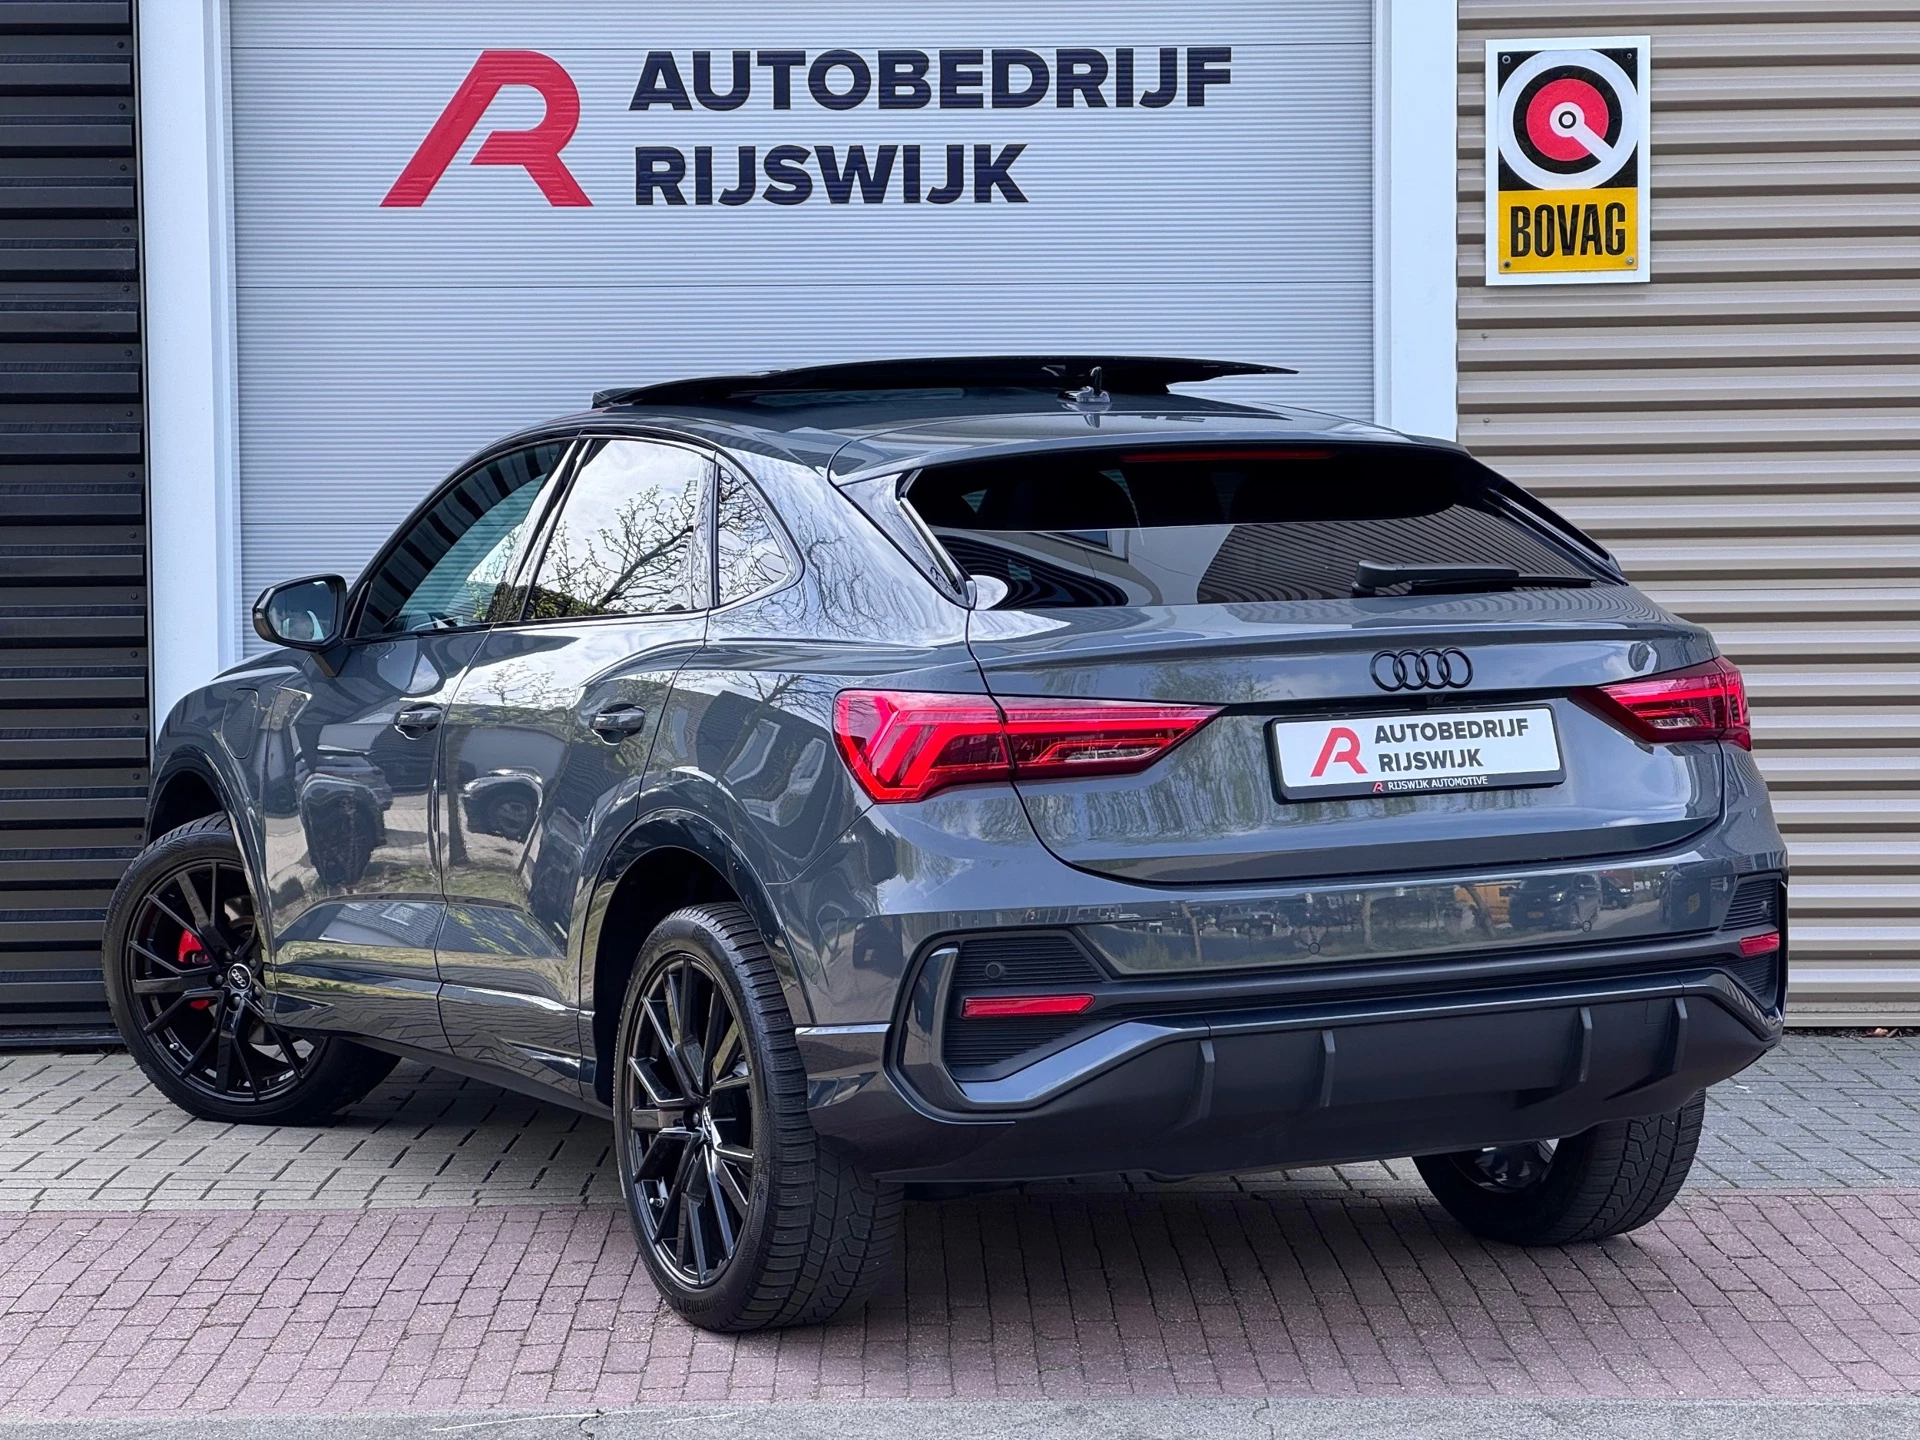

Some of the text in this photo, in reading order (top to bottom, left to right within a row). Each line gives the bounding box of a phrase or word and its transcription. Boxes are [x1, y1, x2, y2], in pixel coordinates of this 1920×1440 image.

[629, 47, 1232, 112] AUTOBEDRIJF
[634, 143, 1029, 207] RIJSWIJK
[1510, 202, 1627, 258] BOVAG
[1374, 717, 1529, 744] AUTOBEDRIJF
[1378, 748, 1484, 773] RIJSWIJK
[1388, 780, 1430, 791] RIJSWIJK
[1431, 775, 1489, 788] AUTOMOTIVE
